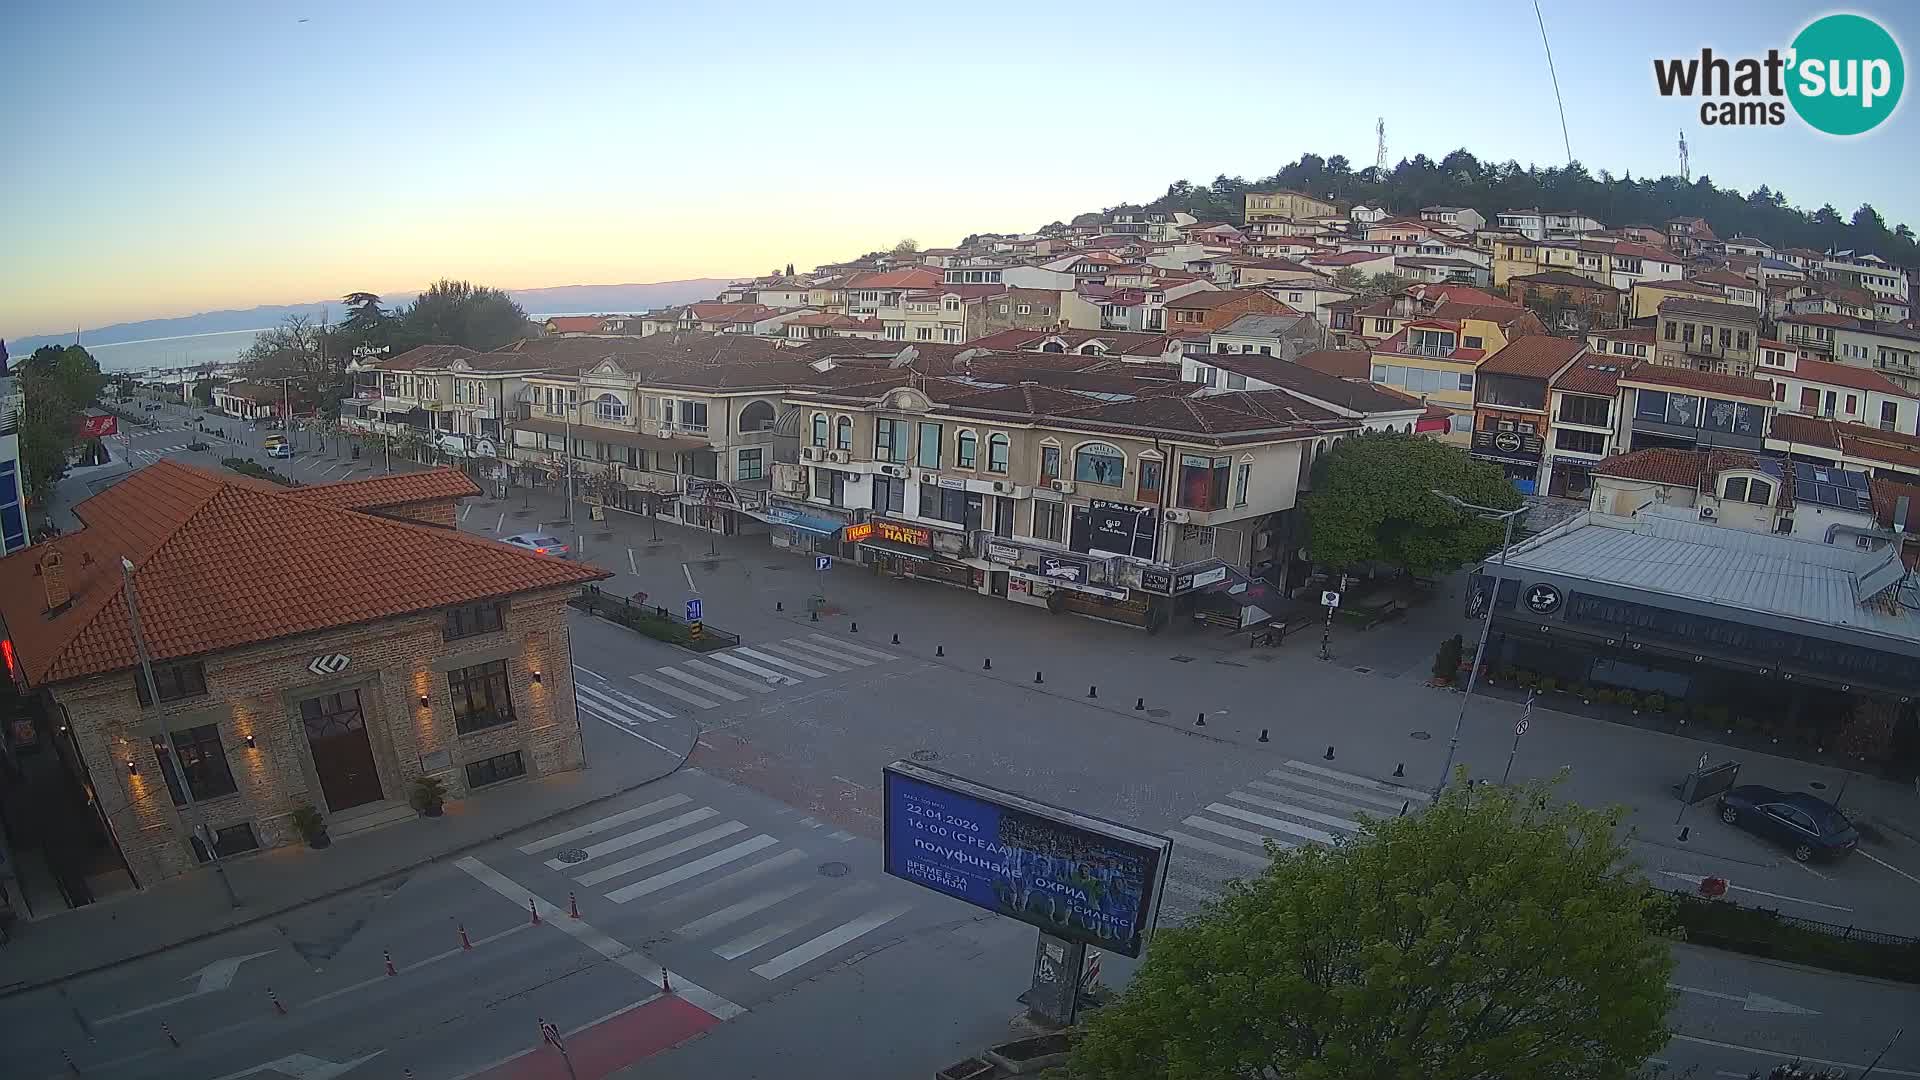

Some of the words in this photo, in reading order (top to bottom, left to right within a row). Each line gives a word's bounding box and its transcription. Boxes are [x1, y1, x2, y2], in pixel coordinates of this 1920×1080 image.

[906, 803, 979, 832] 22.04.2026
[907, 818, 948, 836] 16:00
[914, 838, 1023, 878] полуфинале
[907, 859, 942, 877] ВРЕМЕ
[954, 874, 968, 886] ЗА
[1035, 878, 1087, 901] ОХРИД
[1073, 905, 1129, 927] СИЛЕКС
